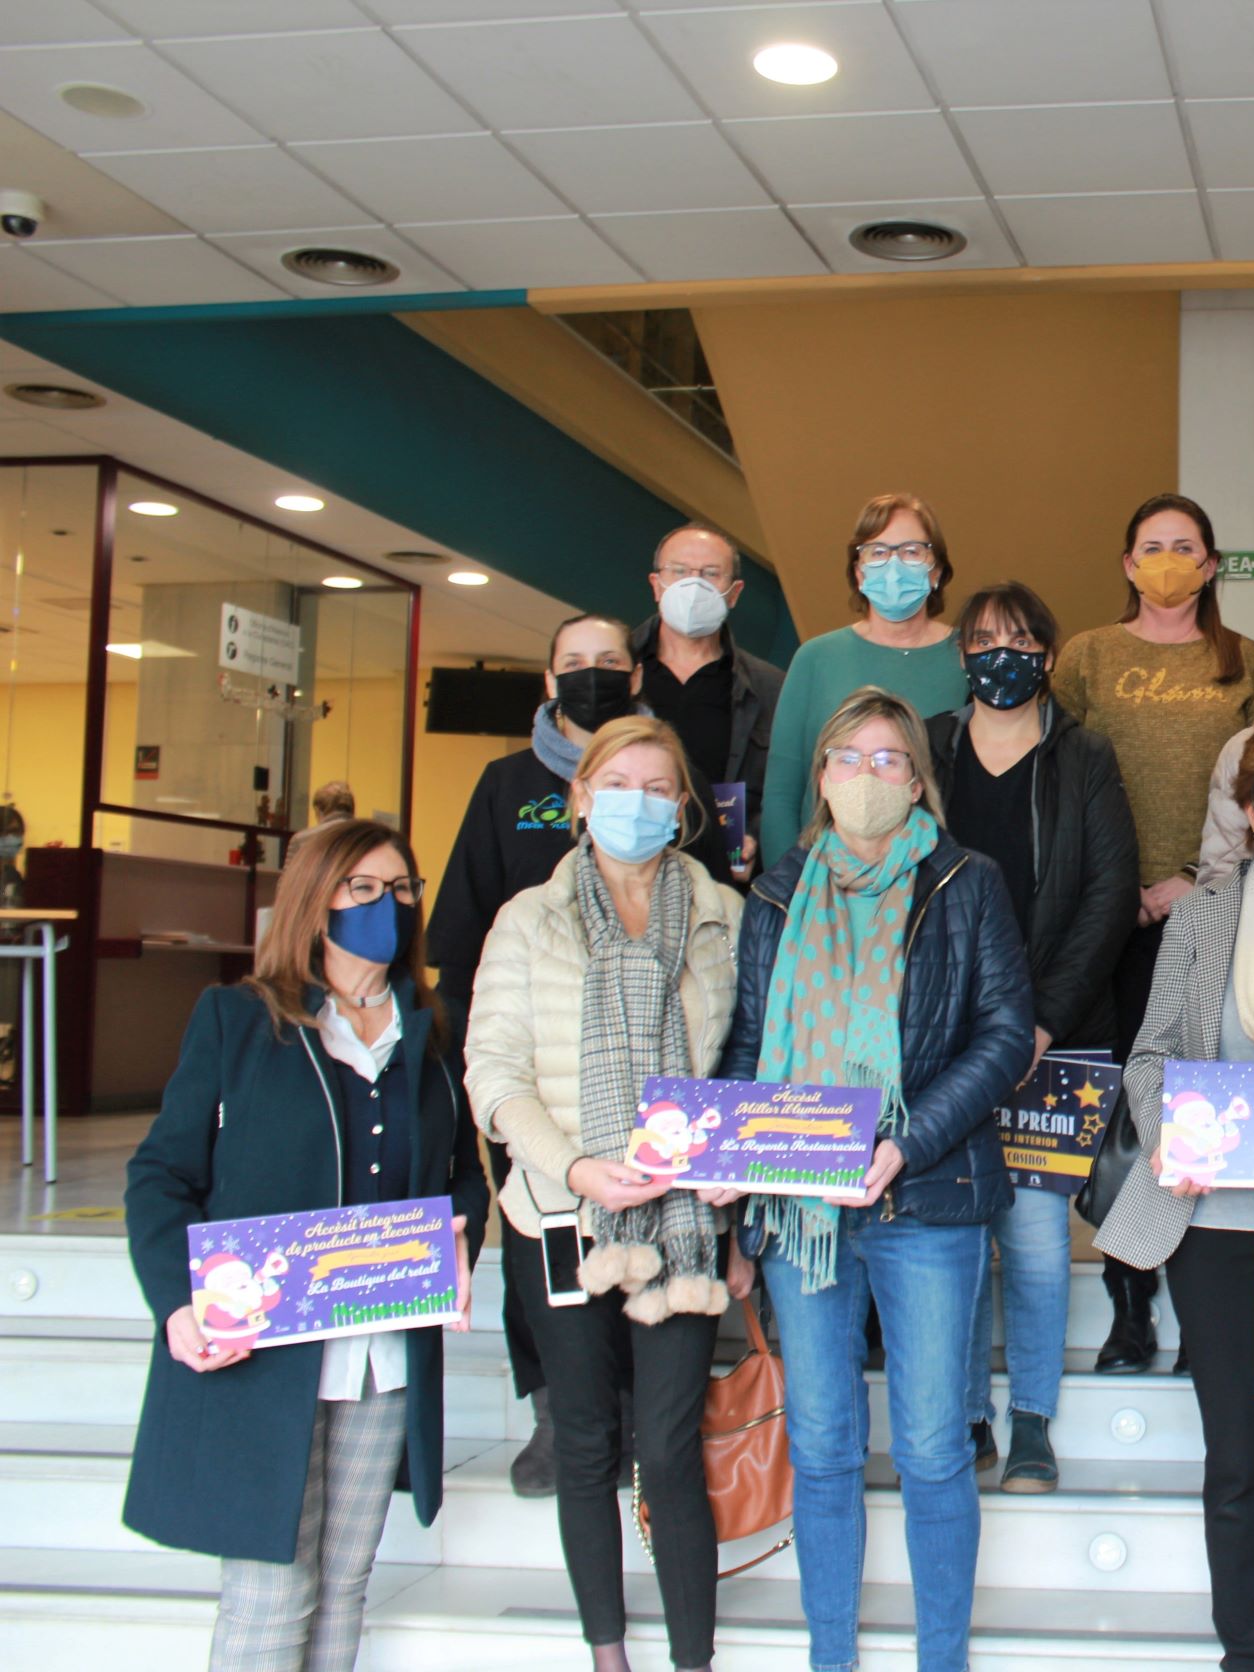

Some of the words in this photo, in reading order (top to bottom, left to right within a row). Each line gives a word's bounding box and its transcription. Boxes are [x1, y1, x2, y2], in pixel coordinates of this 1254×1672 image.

[772, 1090, 822, 1103] Accèsit
[735, 1103, 779, 1116] Millor
[1017, 1110, 1075, 1136] PREMI
[720, 1140, 737, 1151] La
[742, 1140, 789, 1153] Regenta
[792, 1140, 866, 1152] Restauración
[1014, 1134, 1058, 1148] INTERIOR
[1007, 1151, 1047, 1167] CASINOS
[305, 1216, 358, 1238] Accèsit
[358, 1207, 424, 1232] integració
[285, 1242, 300, 1257] de
[299, 1234, 362, 1259] producte
[363, 1233, 381, 1243] en
[381, 1219, 443, 1242] decoració
[307, 1282, 329, 1297] La
[332, 1274, 386, 1293] Boutique
[387, 1267, 407, 1283] del
[407, 1262, 440, 1278] retall
